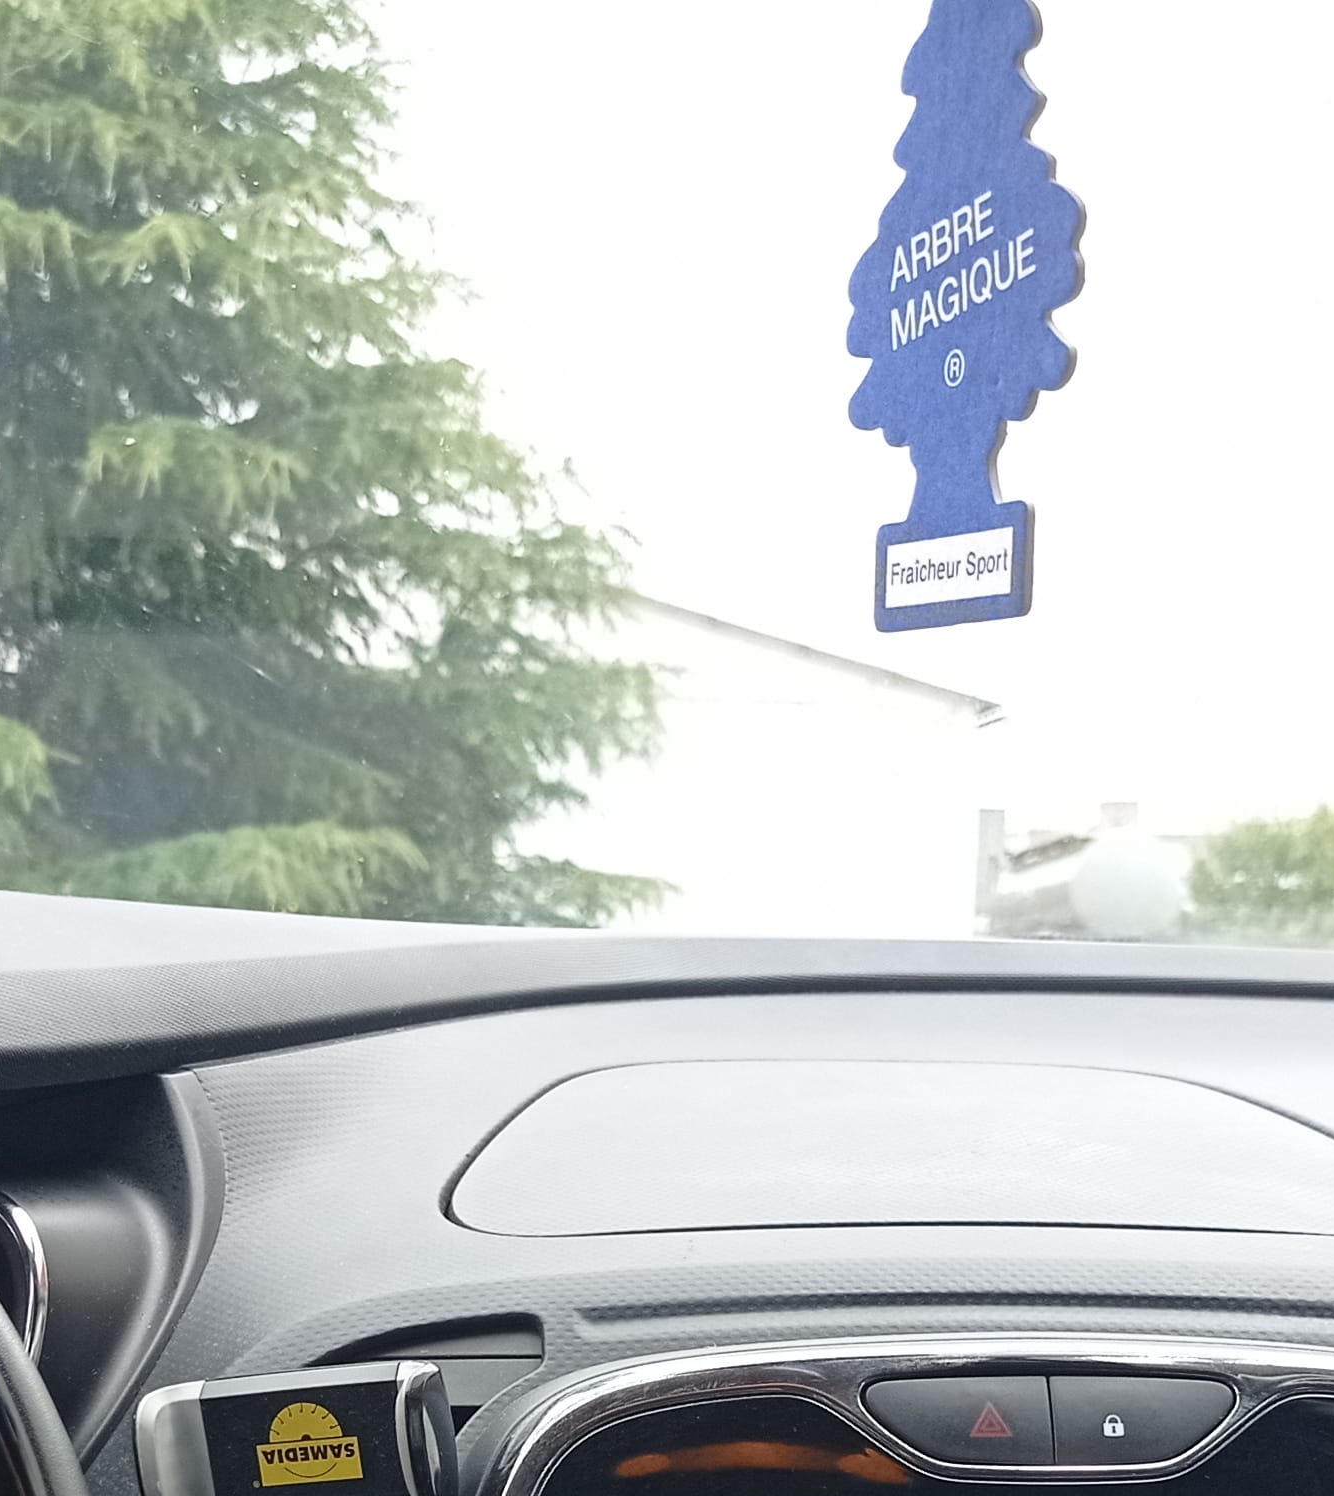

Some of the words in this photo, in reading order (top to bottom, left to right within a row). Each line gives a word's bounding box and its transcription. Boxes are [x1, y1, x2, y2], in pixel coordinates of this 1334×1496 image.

[891, 191, 995, 292] ARBRE
[890, 228, 1037, 351] MAGIQUE
[890, 557, 961, 587] Fraîcheur
[964, 547, 1009, 583] Sport
[262, 1442, 355, 1465] SAMEDIA
